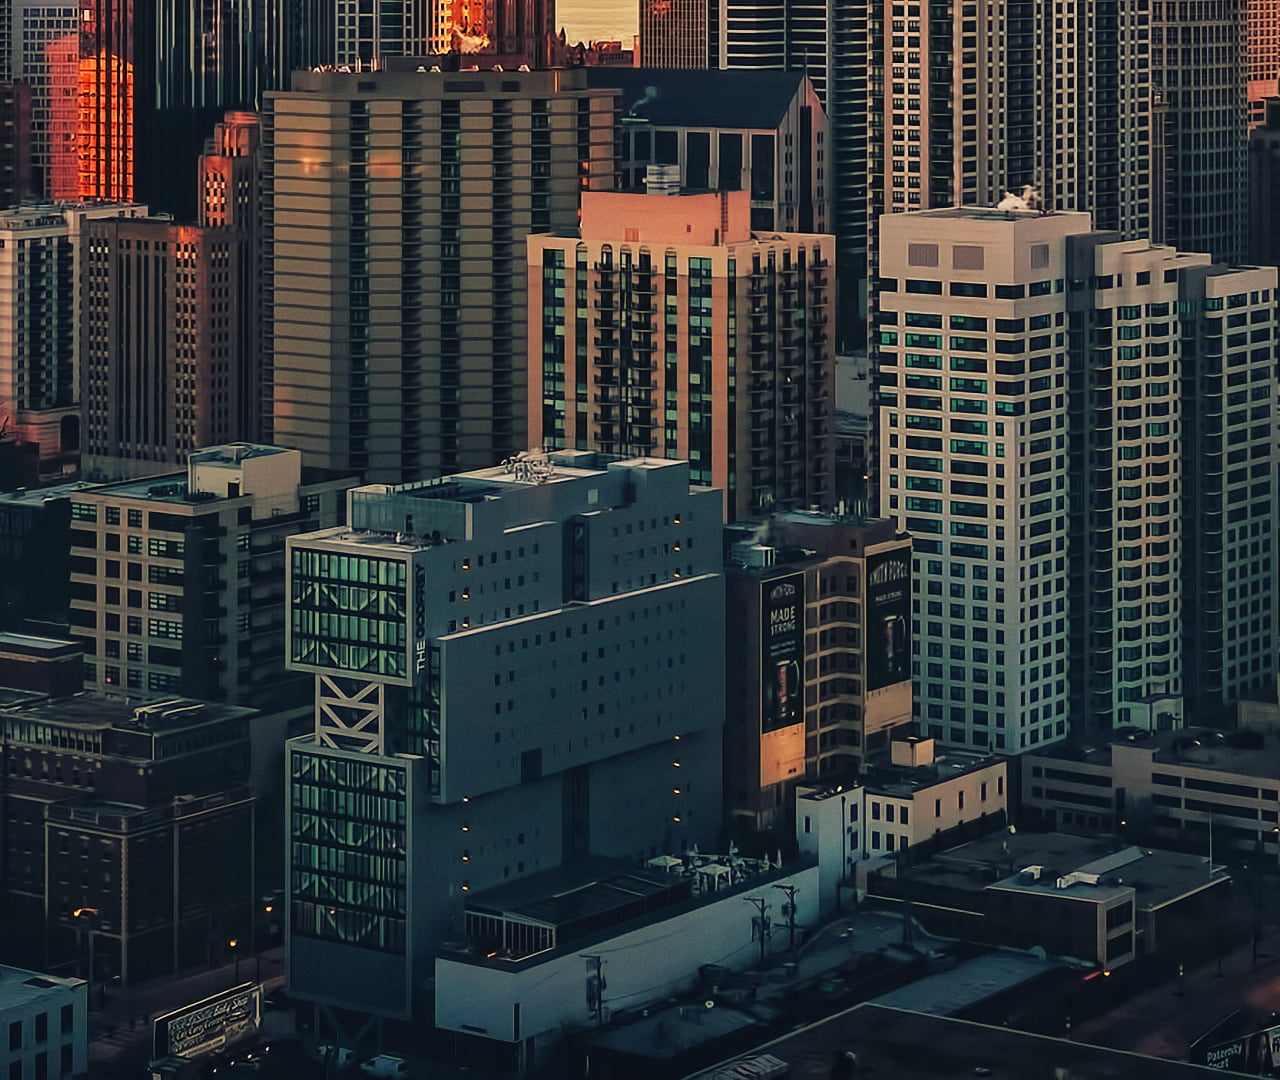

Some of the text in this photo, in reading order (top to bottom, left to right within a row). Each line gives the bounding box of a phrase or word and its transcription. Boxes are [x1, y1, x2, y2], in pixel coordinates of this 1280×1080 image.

[770, 605, 796, 625] MADE
[770, 619, 796, 637] STRONG
[416, 639, 426, 675] THE
[1206, 1043, 1243, 1063] Paternity
